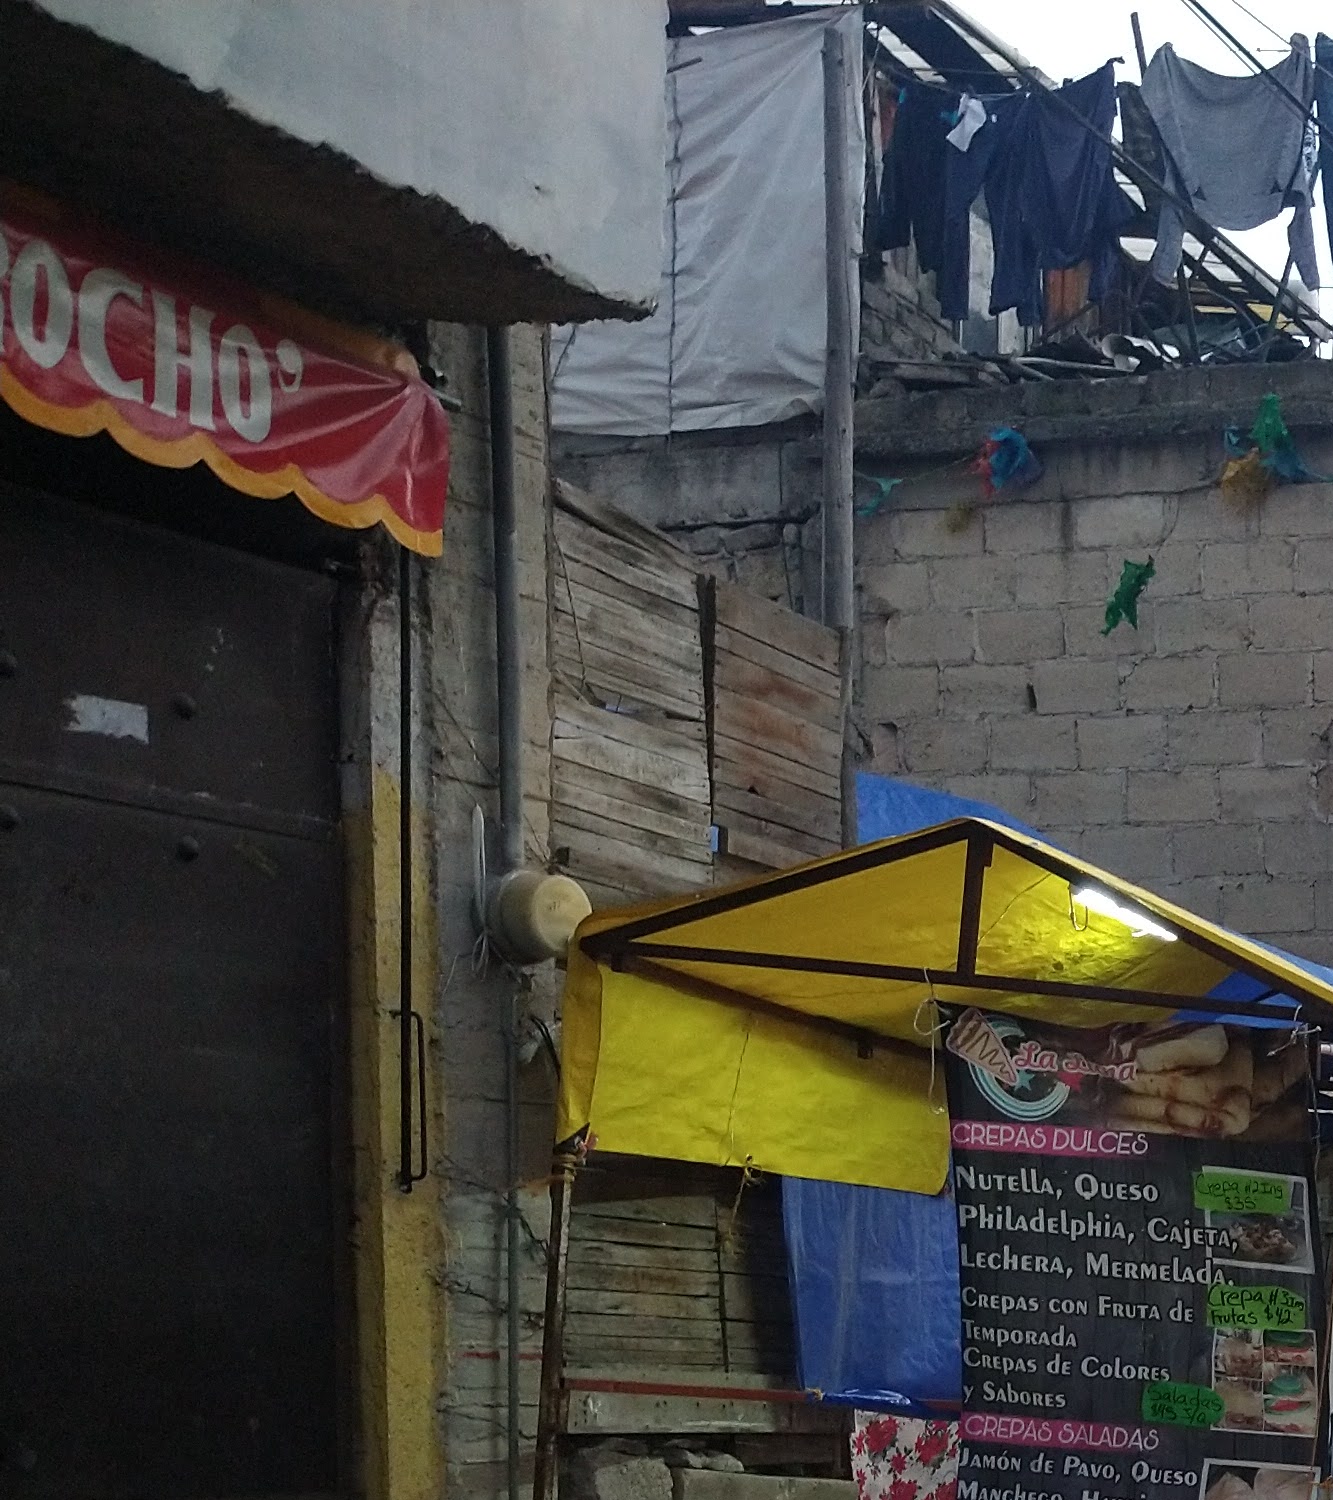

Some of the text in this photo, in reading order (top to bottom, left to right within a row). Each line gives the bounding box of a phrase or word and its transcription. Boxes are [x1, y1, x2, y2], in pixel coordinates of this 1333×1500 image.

[1012, 1041, 1058, 1071] La
[953, 1122, 1148, 1155] CREPAS DULCES
[956, 1165, 1159, 1202] Nutella, Queso
[1195, 1174, 1239, 1197] Crepa
[959, 1204, 1239, 1254] Philadelphia, Cajeta,
[961, 1243, 1235, 1287] Lechera, Mermelada.
[962, 1287, 1194, 1323] Crepas con Fruta de
[1208, 1284, 1264, 1310] Crepa
[962, 1319, 1078, 1348] Temporada
[1211, 1308, 1258, 1325] Frutas
[963, 1347, 1171, 1382] Crepas de Colores
[963, 1381, 1066, 1408] y Sabores
[964, 1414, 1160, 1450] CREPAS SALADAS
[958, 1448, 1198, 1487] Jamón de Pavo, Queso
